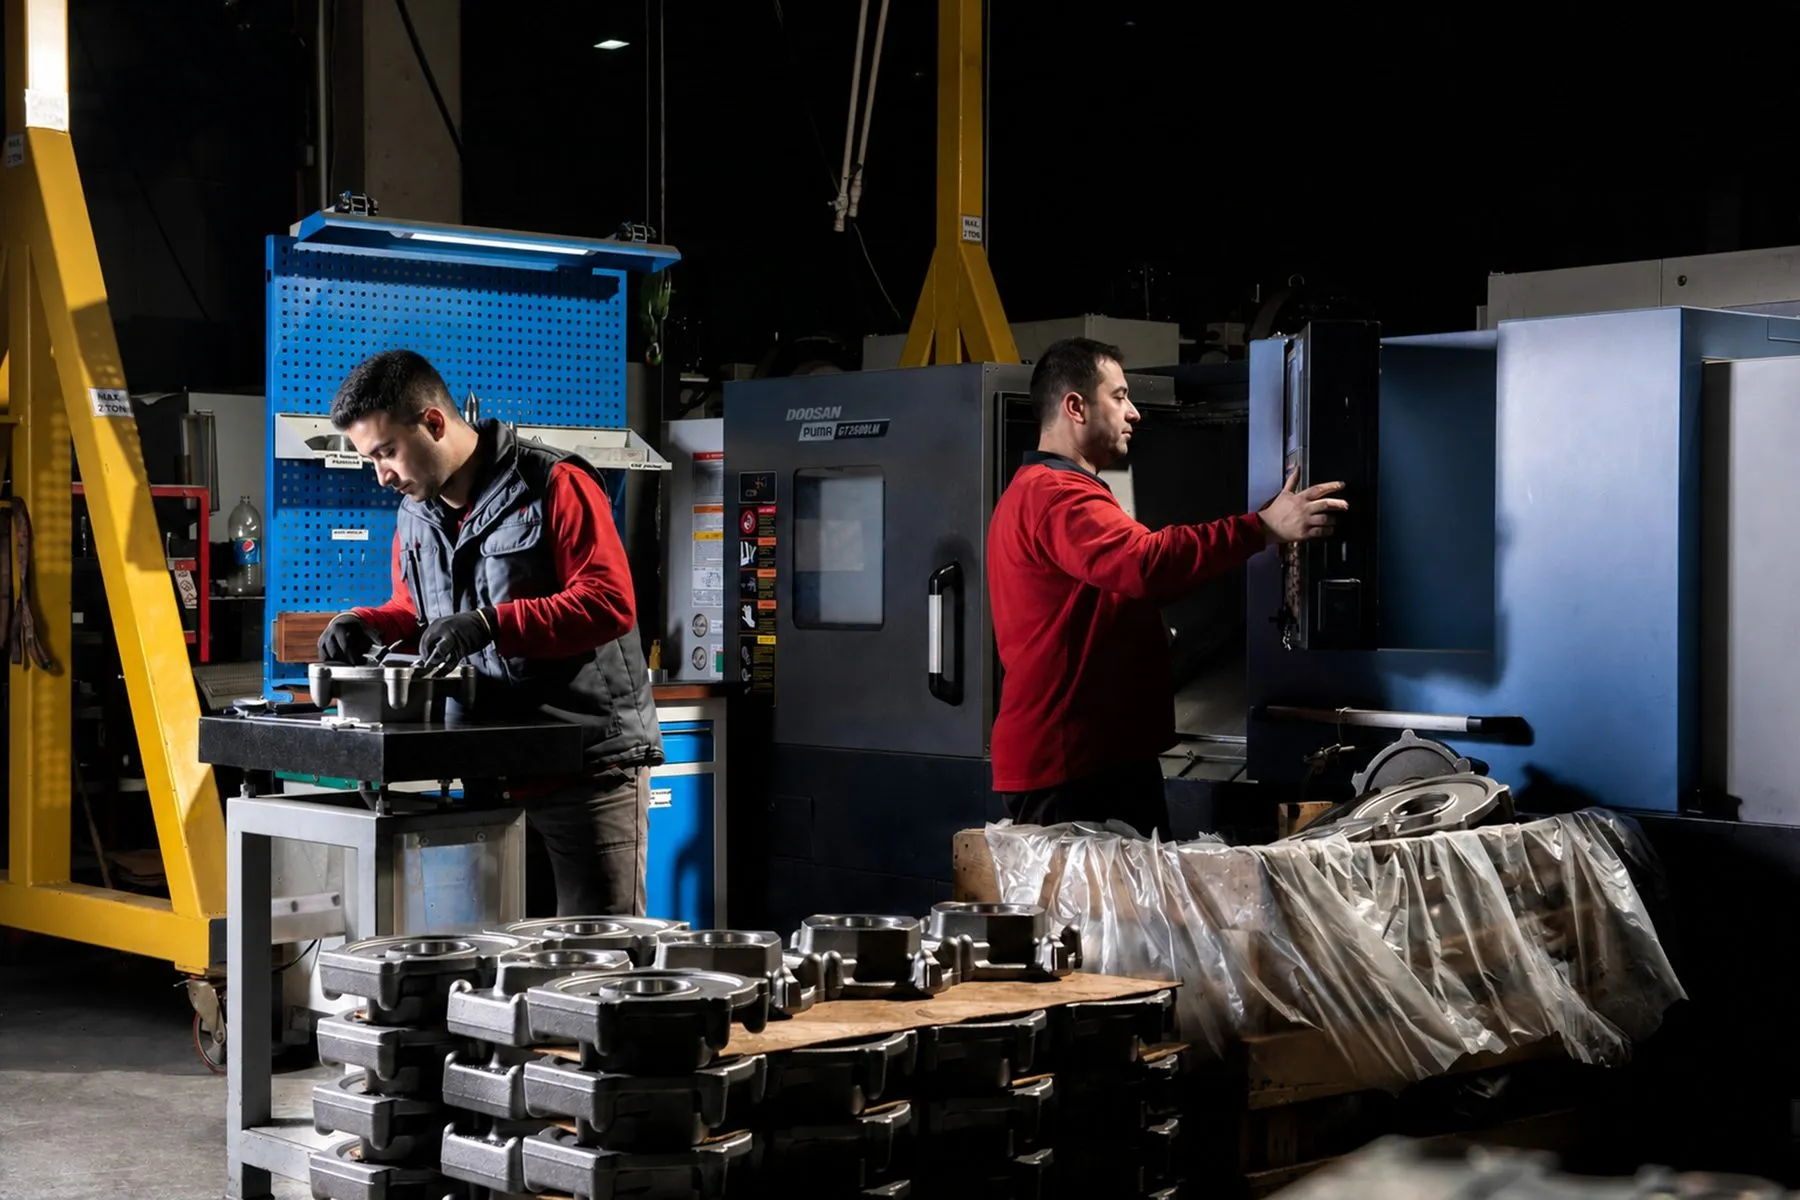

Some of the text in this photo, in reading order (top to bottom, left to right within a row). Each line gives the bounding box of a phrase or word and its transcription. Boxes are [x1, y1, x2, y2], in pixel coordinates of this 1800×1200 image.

[97, 403, 127, 413] 2 TON
[785, 405, 842, 421] DOOSAN
[803, 426, 833, 438] PUMA
